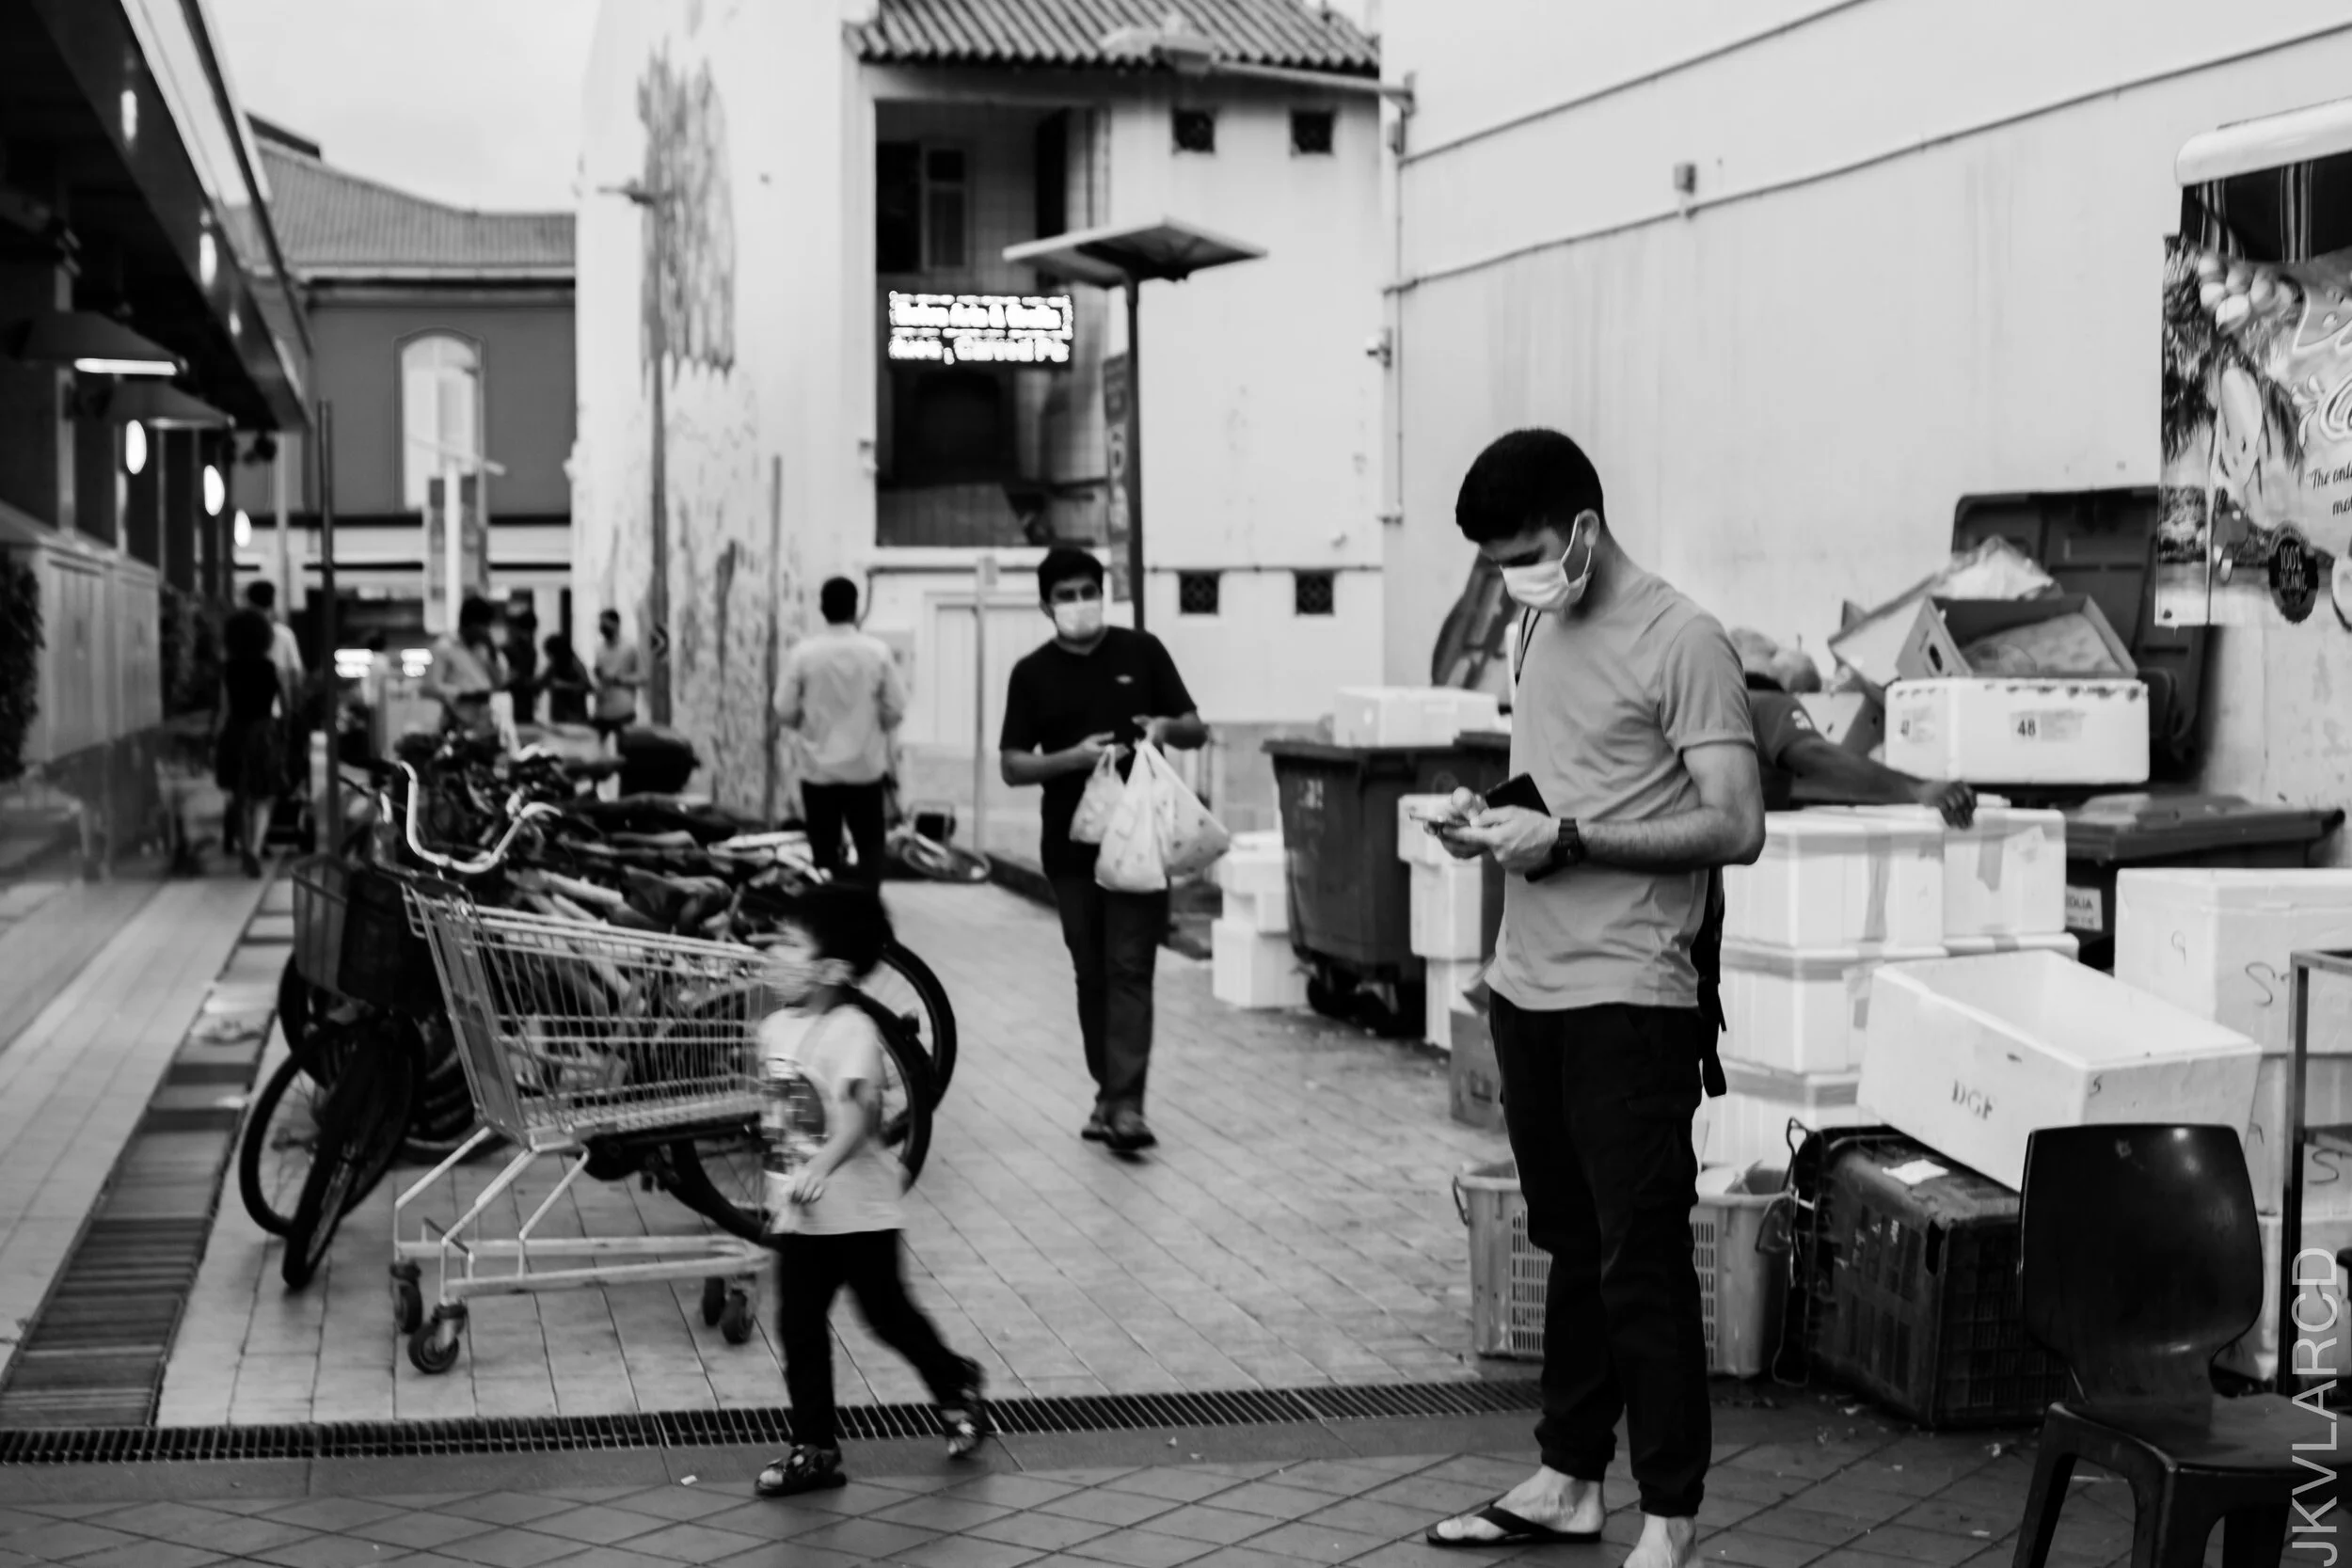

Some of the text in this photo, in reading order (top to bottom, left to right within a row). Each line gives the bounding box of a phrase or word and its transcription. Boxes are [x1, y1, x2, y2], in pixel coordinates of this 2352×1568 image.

[2332, 460, 2352, 483] onl
[2332, 496, 2352, 516] mo
[2017, 718, 2037, 737] 48
